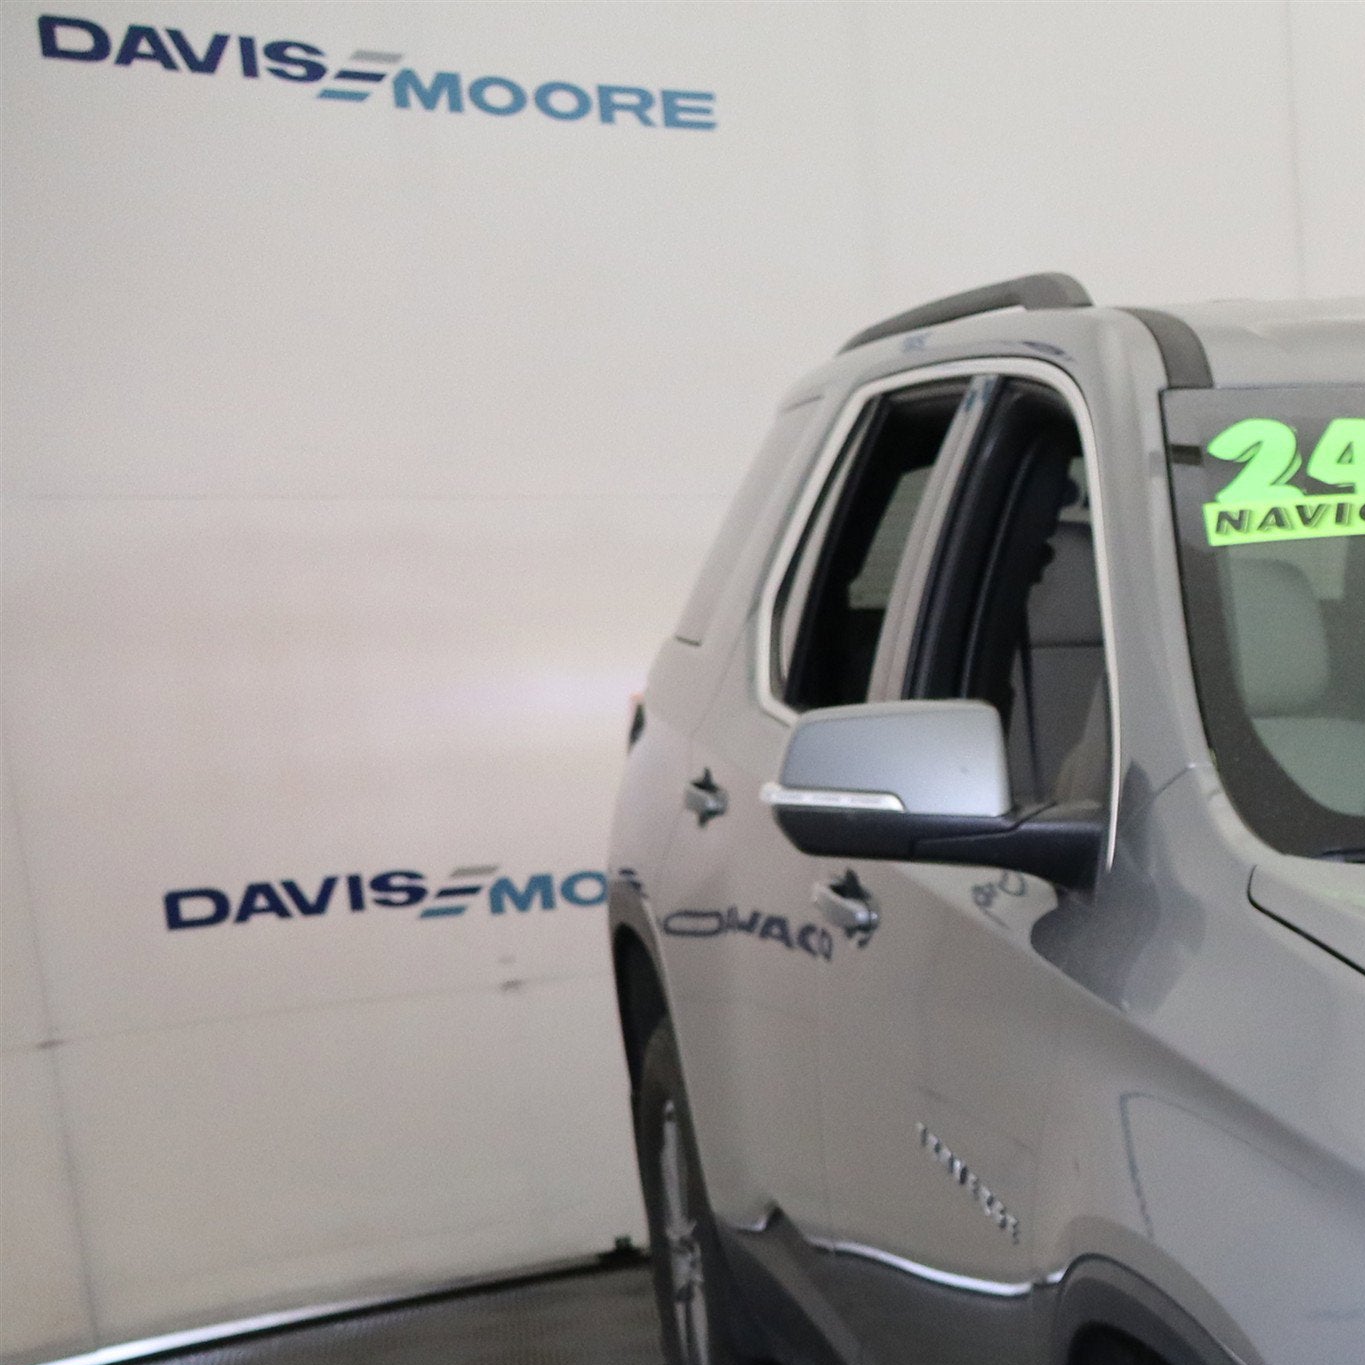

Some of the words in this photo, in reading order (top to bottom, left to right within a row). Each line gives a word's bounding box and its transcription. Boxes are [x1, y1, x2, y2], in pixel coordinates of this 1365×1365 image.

[37, 15, 328, 83] DAVIS
[391, 68, 717, 131] MOORE
[163, 870, 427, 931] DAVIS
